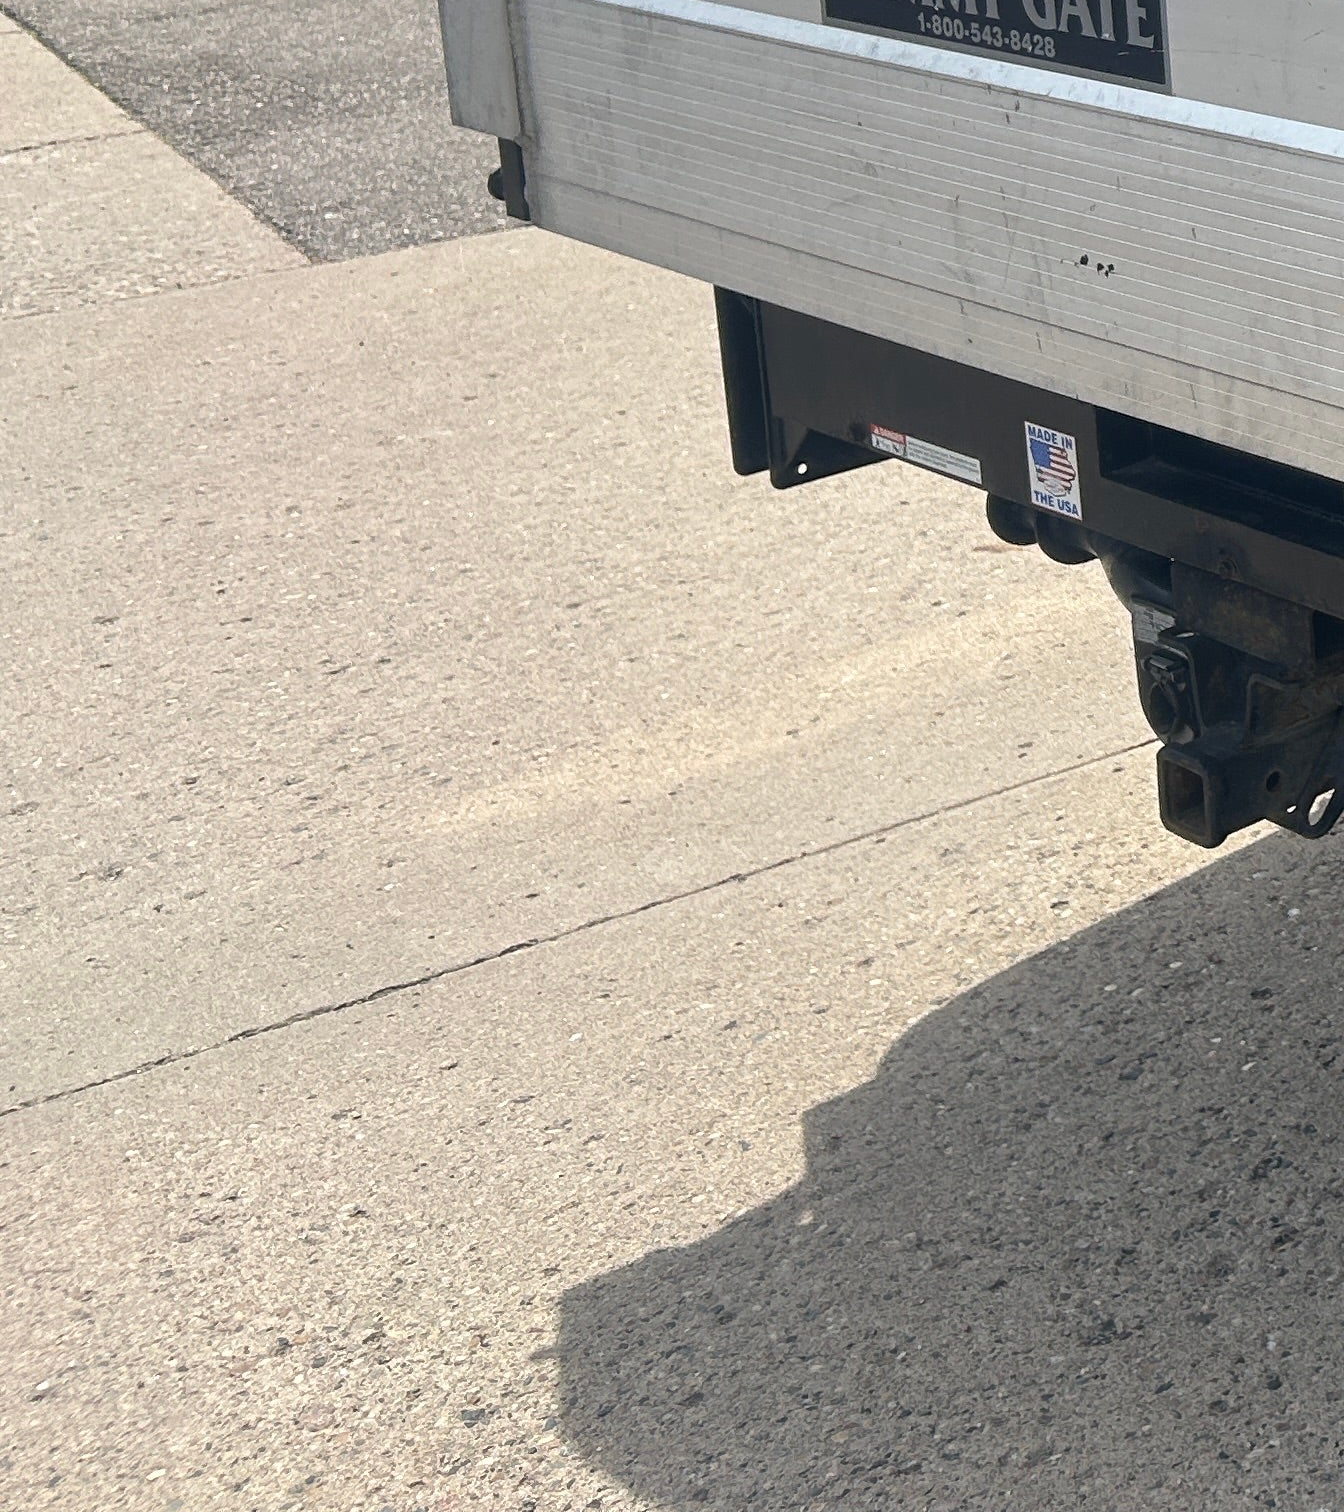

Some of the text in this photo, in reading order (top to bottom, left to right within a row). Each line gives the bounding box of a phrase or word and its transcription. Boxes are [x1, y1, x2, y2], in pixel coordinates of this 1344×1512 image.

[918, 12, 1056, 58] 1-800-543-8428
[1028, 425, 1073, 449] MADE IN
[1034, 491, 1079, 517] THE USA
